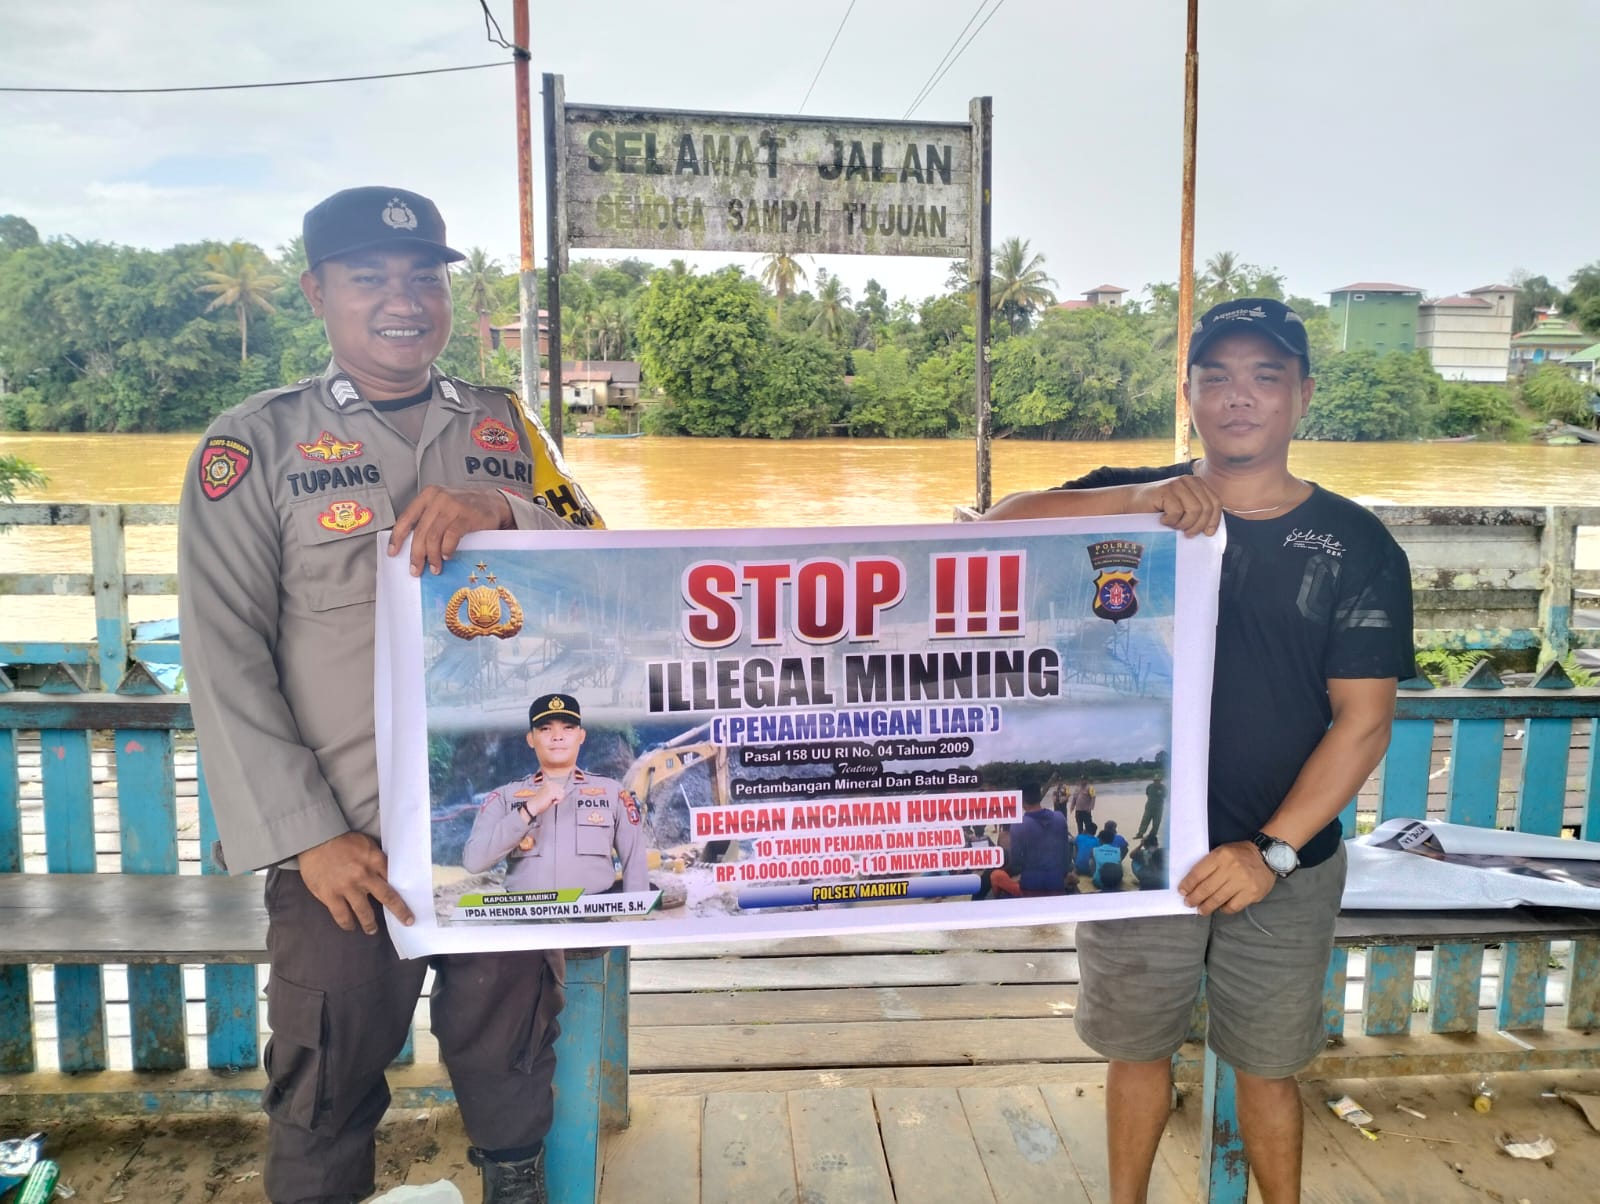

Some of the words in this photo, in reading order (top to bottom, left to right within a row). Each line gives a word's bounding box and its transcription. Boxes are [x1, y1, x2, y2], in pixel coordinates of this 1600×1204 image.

[588, 128, 786, 179] SELAMAT
[817, 137, 952, 186] JALAN
[595, 194, 706, 233] SEMOGA
[727, 198, 821, 235] SAMPAI
[842, 201, 947, 238] TUJUAN
[287, 463, 380, 498] TUPANG
[465, 456, 532, 484] POLRI
[1095, 541, 1137, 551] POLRES
[685, 557, 903, 646] STOP
[935, 554, 1021, 634] !!!
[648, 657, 833, 712] ILLEGAL
[845, 648, 1059, 703] MINNING
[744, 751, 780, 763] Pasal
[785, 749, 807, 761] 158
[811, 748, 831, 759] UU
[834, 747, 848, 759] RI
[852, 746, 874, 758] No.
[877, 745, 893, 757] 04
[896, 744, 936, 756] Tahun
[939, 742, 969, 754] 2009
[838, 762, 878, 775] Tentang
[736, 781, 831, 796] Pertambangan
[834, 777, 882, 790] Mineral
[886, 776, 911, 788] Dan
[915, 775, 944, 787] Batu
[948, 773, 978, 785] Bara
[577, 799, 610, 808] POLRI
[696, 807, 786, 837] DENGAN
[791, 801, 902, 830] ANCAMAN
[907, 796, 1017, 824] HUKUMAN
[755, 840, 772, 857] 10
[775, 837, 821, 856] TAHUN
[824, 833, 883, 853] PENJARA
[886, 832, 914, 849] DAN
[917, 829, 963, 847] DENDA
[716, 866, 736, 882] RP.
[890, 852, 939, 871] MILYAR
[483, 895, 524, 904] KAPOLSEK
[525, 893, 557, 902] MARIKIT
[812, 883, 858, 901] POLSEK
[860, 881, 909, 899] MARIKIT
[465, 908, 487, 918] IPDA
[489, 907, 528, 918] HENDRA
[531, 905, 570, 916] SOPIYAN
[573, 904, 582, 914] D.
[584, 902, 626, 914] MUNTHE,
[628, 901, 647, 911] S.H.
